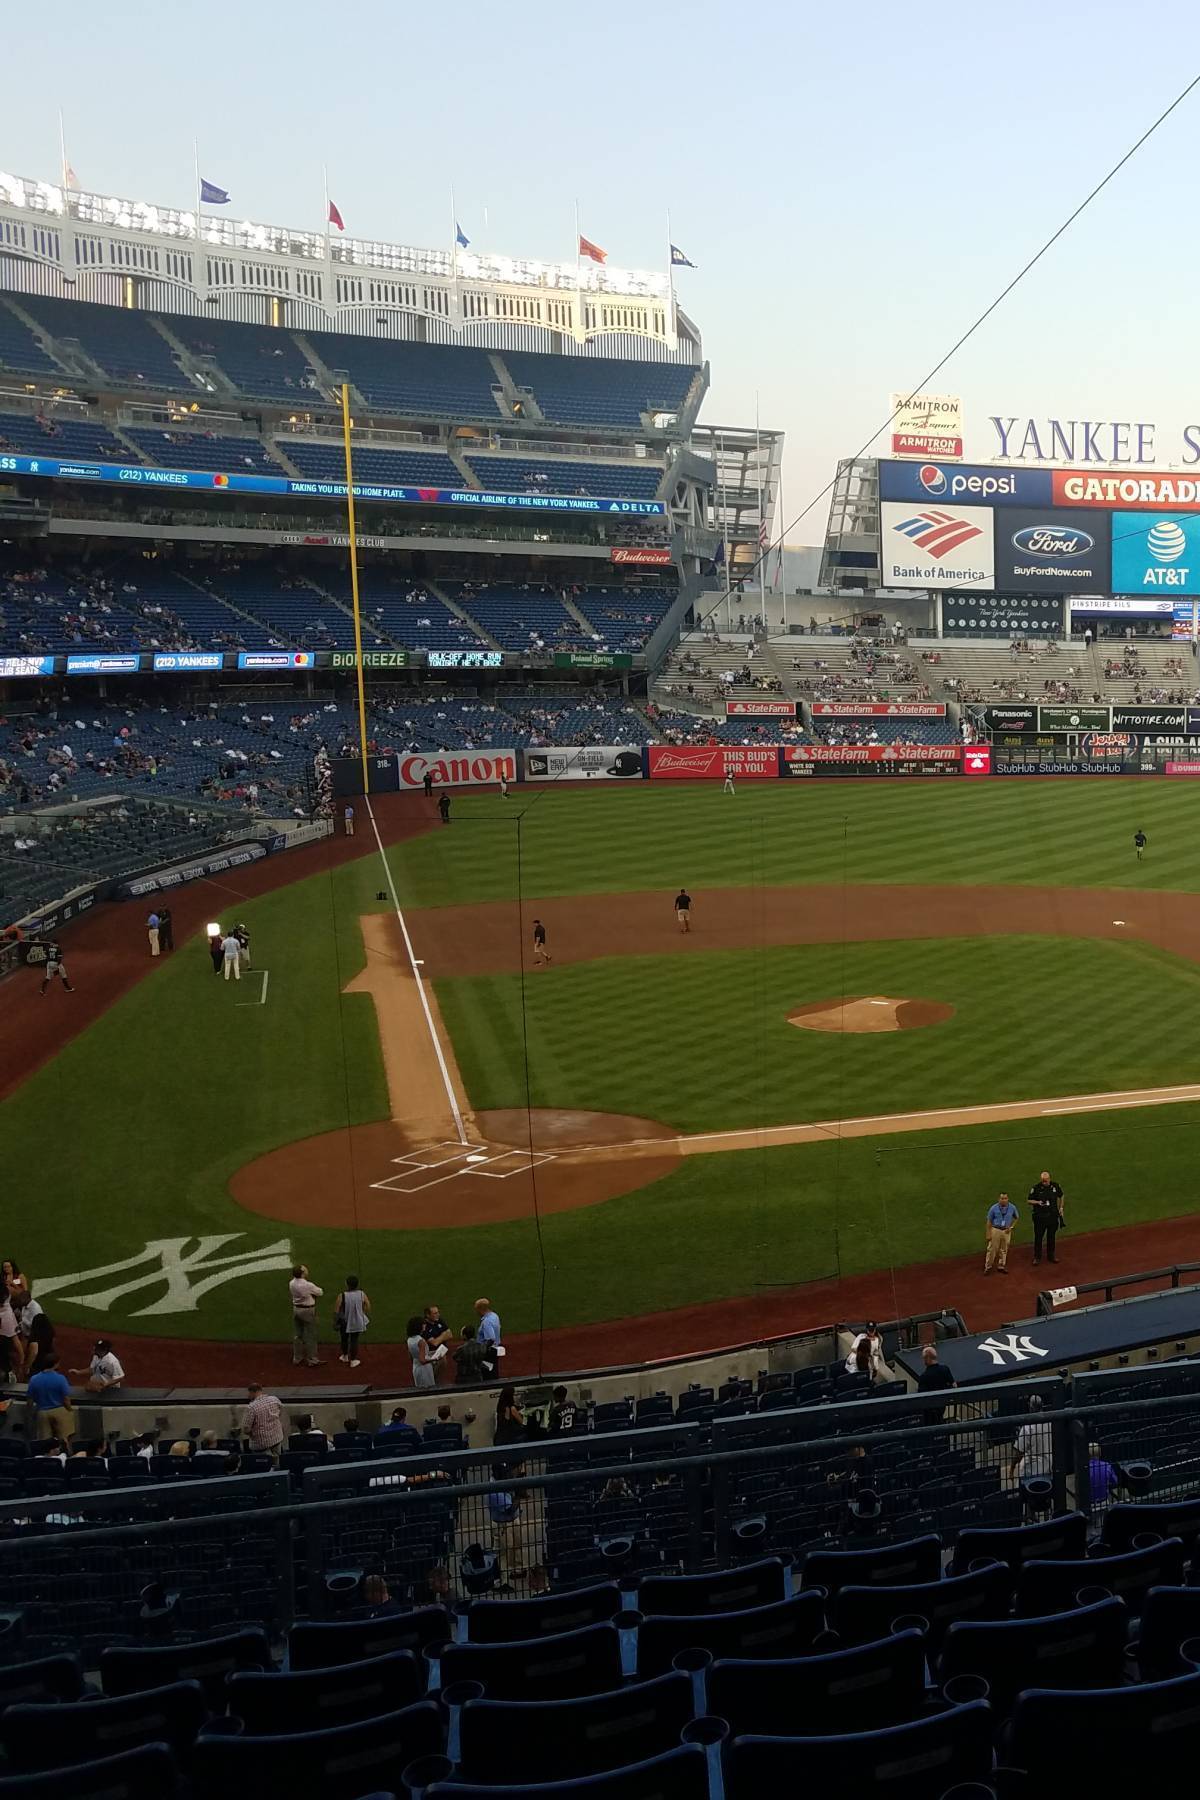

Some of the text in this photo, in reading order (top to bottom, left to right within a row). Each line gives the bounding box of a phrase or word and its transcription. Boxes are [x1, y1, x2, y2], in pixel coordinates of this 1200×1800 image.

[895, 400, 958, 413] ARMITRON
[900, 436, 956, 449] ARMITRON
[988, 416, 1157, 465] YANKEE
[59, 466, 100, 475] yankees.com
[119, 470, 188, 484] (212) YANKEES
[291, 482, 406, 498] TAKING YOU BEYND HOME PLATE.
[952, 474, 1016, 497] pepsi
[451, 493, 600, 509] OFFICIAL AIRLINE OF THE NEW YORK YANKEES.
[622, 502, 660, 513] DELTA
[332, 536, 365, 546] YANKES
[366, 538, 385, 547] CLUB
[1028, 531, 1076, 553] Ford
[613, 549, 671, 563] Budweiser
[893, 565, 985, 580] Bank of America
[1013, 566, 1092, 578] BuyFordNow.com
[1143, 567, 1189, 586] AT&T
[1072, 600, 1111, 609] PINSTRIPE
[155, 656, 219, 667] (212) YANKEES
[332, 653, 405, 667] BiOREEZE
[593, 654, 614, 665] Spring
[992, 709, 1032, 717] Panasonic
[1112, 713, 1184, 727] NITTOTIRE.COM
[1142, 736, 1151, 754] A
[660, 757, 709, 767] Budweiser
[722, 751, 776, 761] THIS BUD'S
[401, 756, 514, 785] Canon
[723, 763, 767, 773] FOR YOU.
[996, 763, 1120, 773] StubHub StubHub StubHub
[977, 1333, 1049, 1366] NY
[560, 1415, 573, 1430] 19
